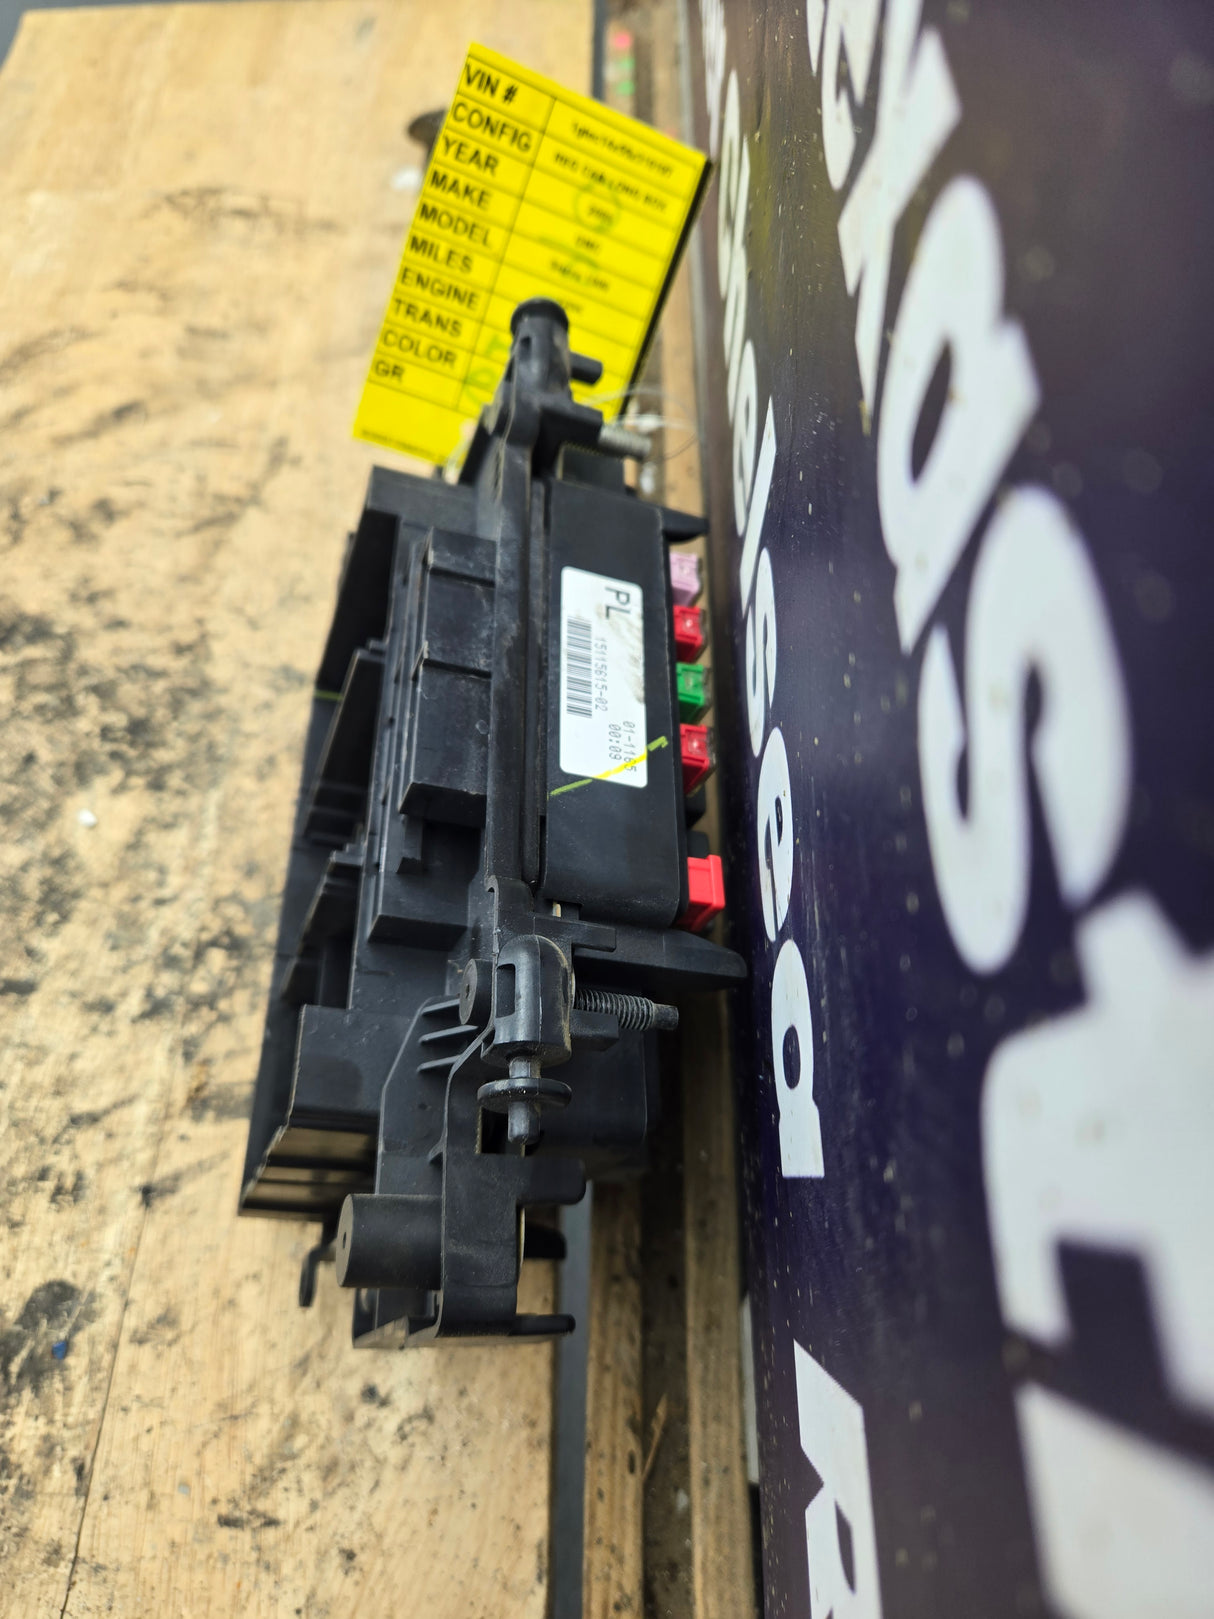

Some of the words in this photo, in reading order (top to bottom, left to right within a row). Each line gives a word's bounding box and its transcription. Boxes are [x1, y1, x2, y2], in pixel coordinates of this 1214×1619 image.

[466, 63, 500, 98] VIN
[501, 84, 518, 105] #
[453, 102, 532, 152] CONFIG
[443, 133, 499, 178] YEAR
[430, 170, 493, 209] MAKE
[419, 203, 491, 248] MODEL
[410, 235, 473, 274] MILES
[401, 267, 479, 310] ENGINE
[391, 298, 463, 338] TRANS
[383, 329, 457, 369] COLOR
[375, 360, 405, 383] GR
[605, 586, 631, 620] PL
[608, 723, 622, 761] 00:09
